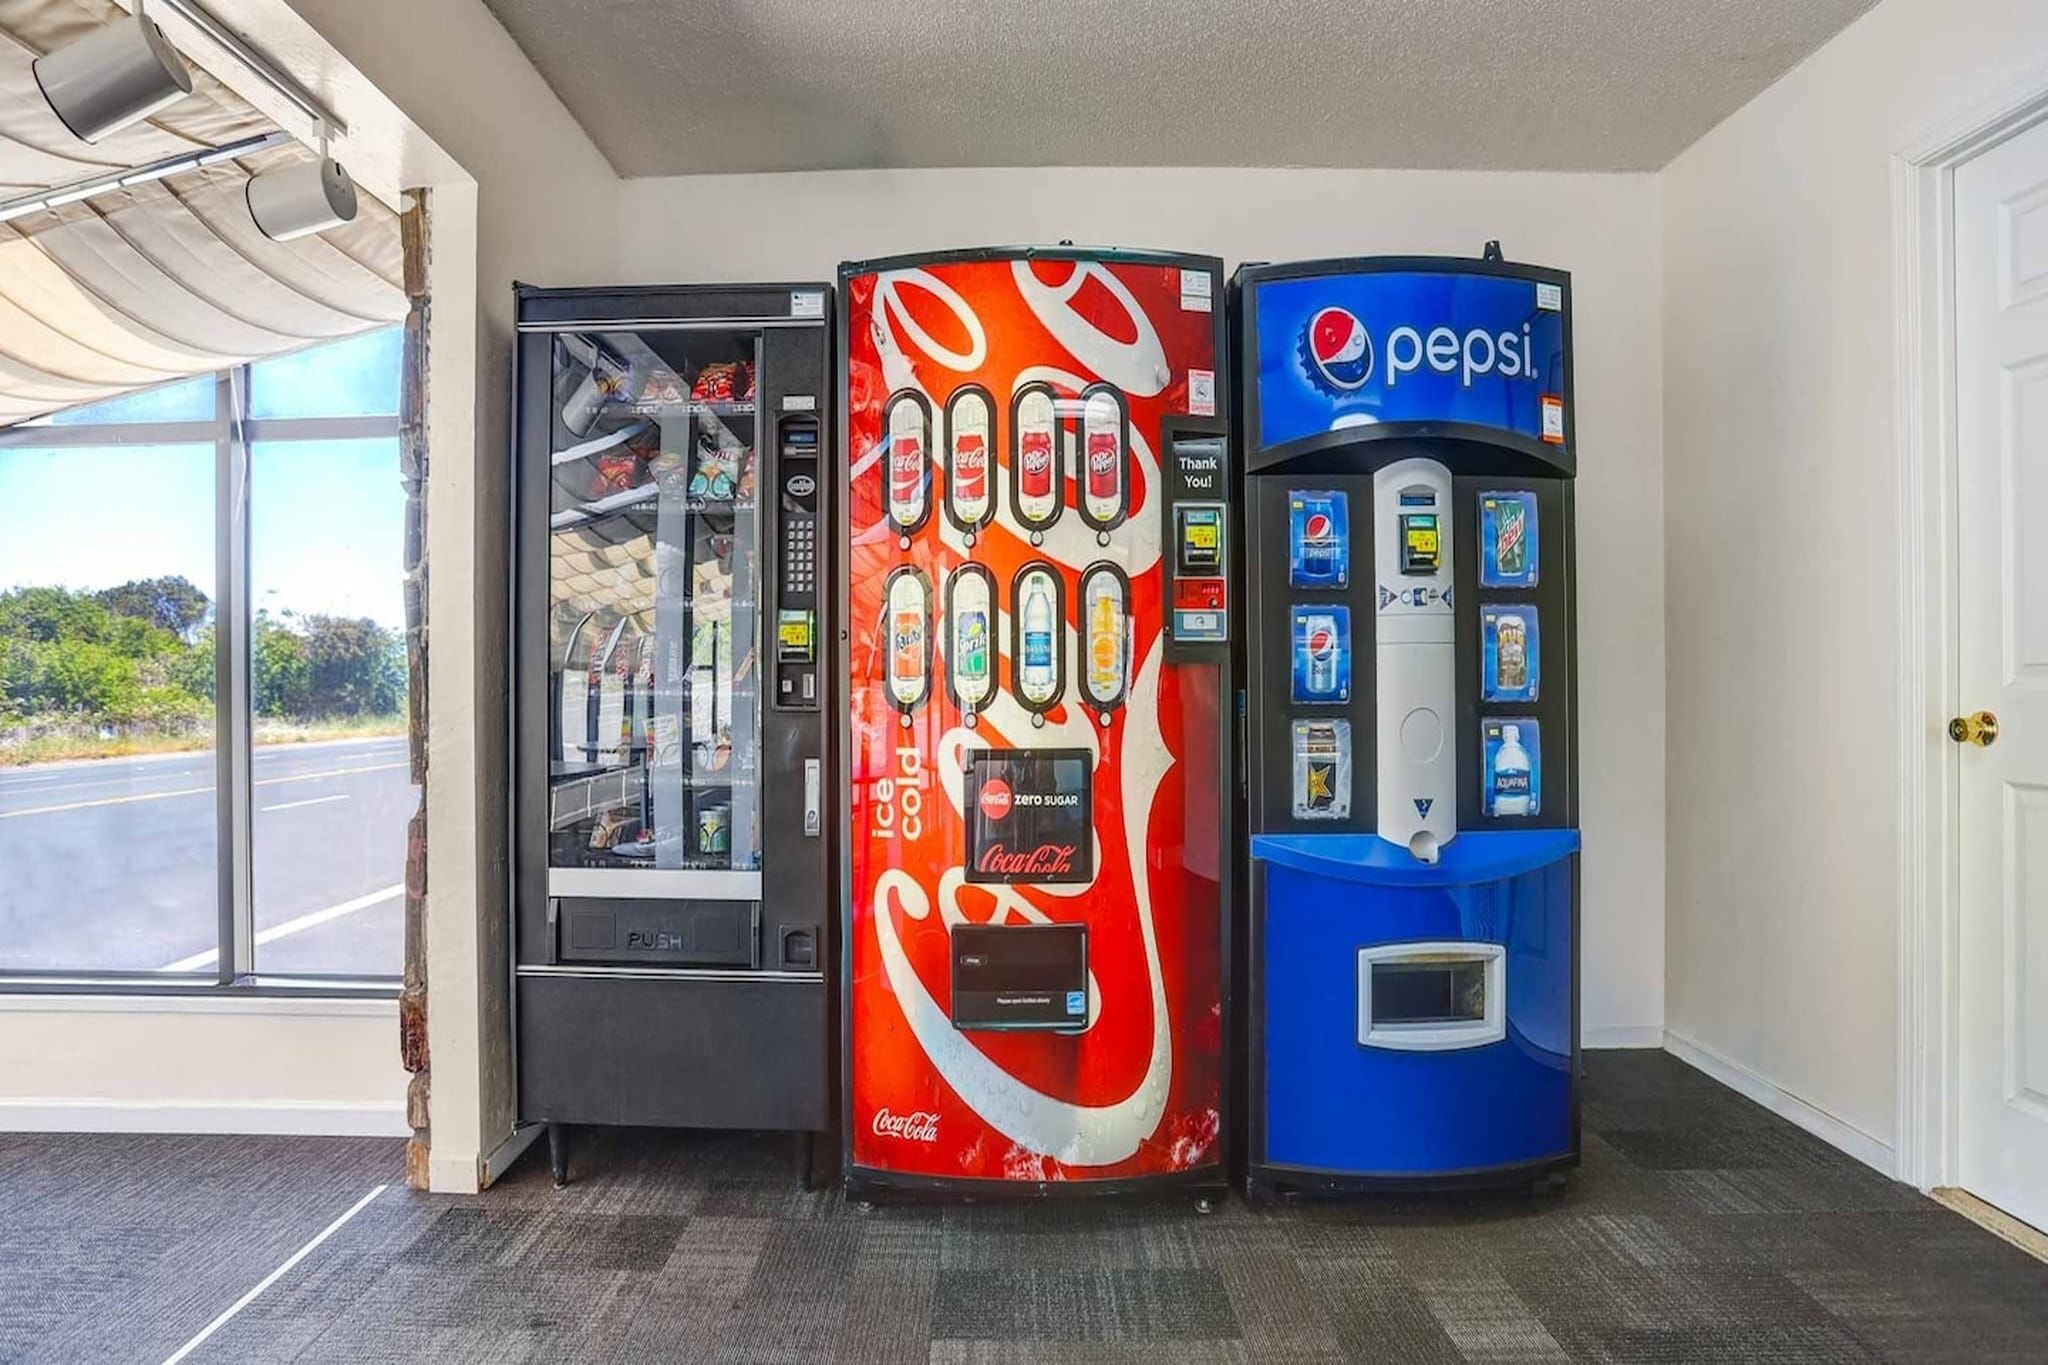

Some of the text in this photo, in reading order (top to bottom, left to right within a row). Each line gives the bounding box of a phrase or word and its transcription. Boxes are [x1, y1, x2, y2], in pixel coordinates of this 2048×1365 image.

[1386, 321, 1532, 387] pepsi
[1179, 457, 1218, 470] Thank
[1184, 475, 1212, 488] You!
[896, 747, 922, 841] cold
[1014, 794, 1043, 805] zero
[1044, 795, 1078, 805] SUGAR
[871, 777, 895, 838] ice
[627, 932, 682, 950] PUSH
[872, 1107, 941, 1142] Coca-Cola
